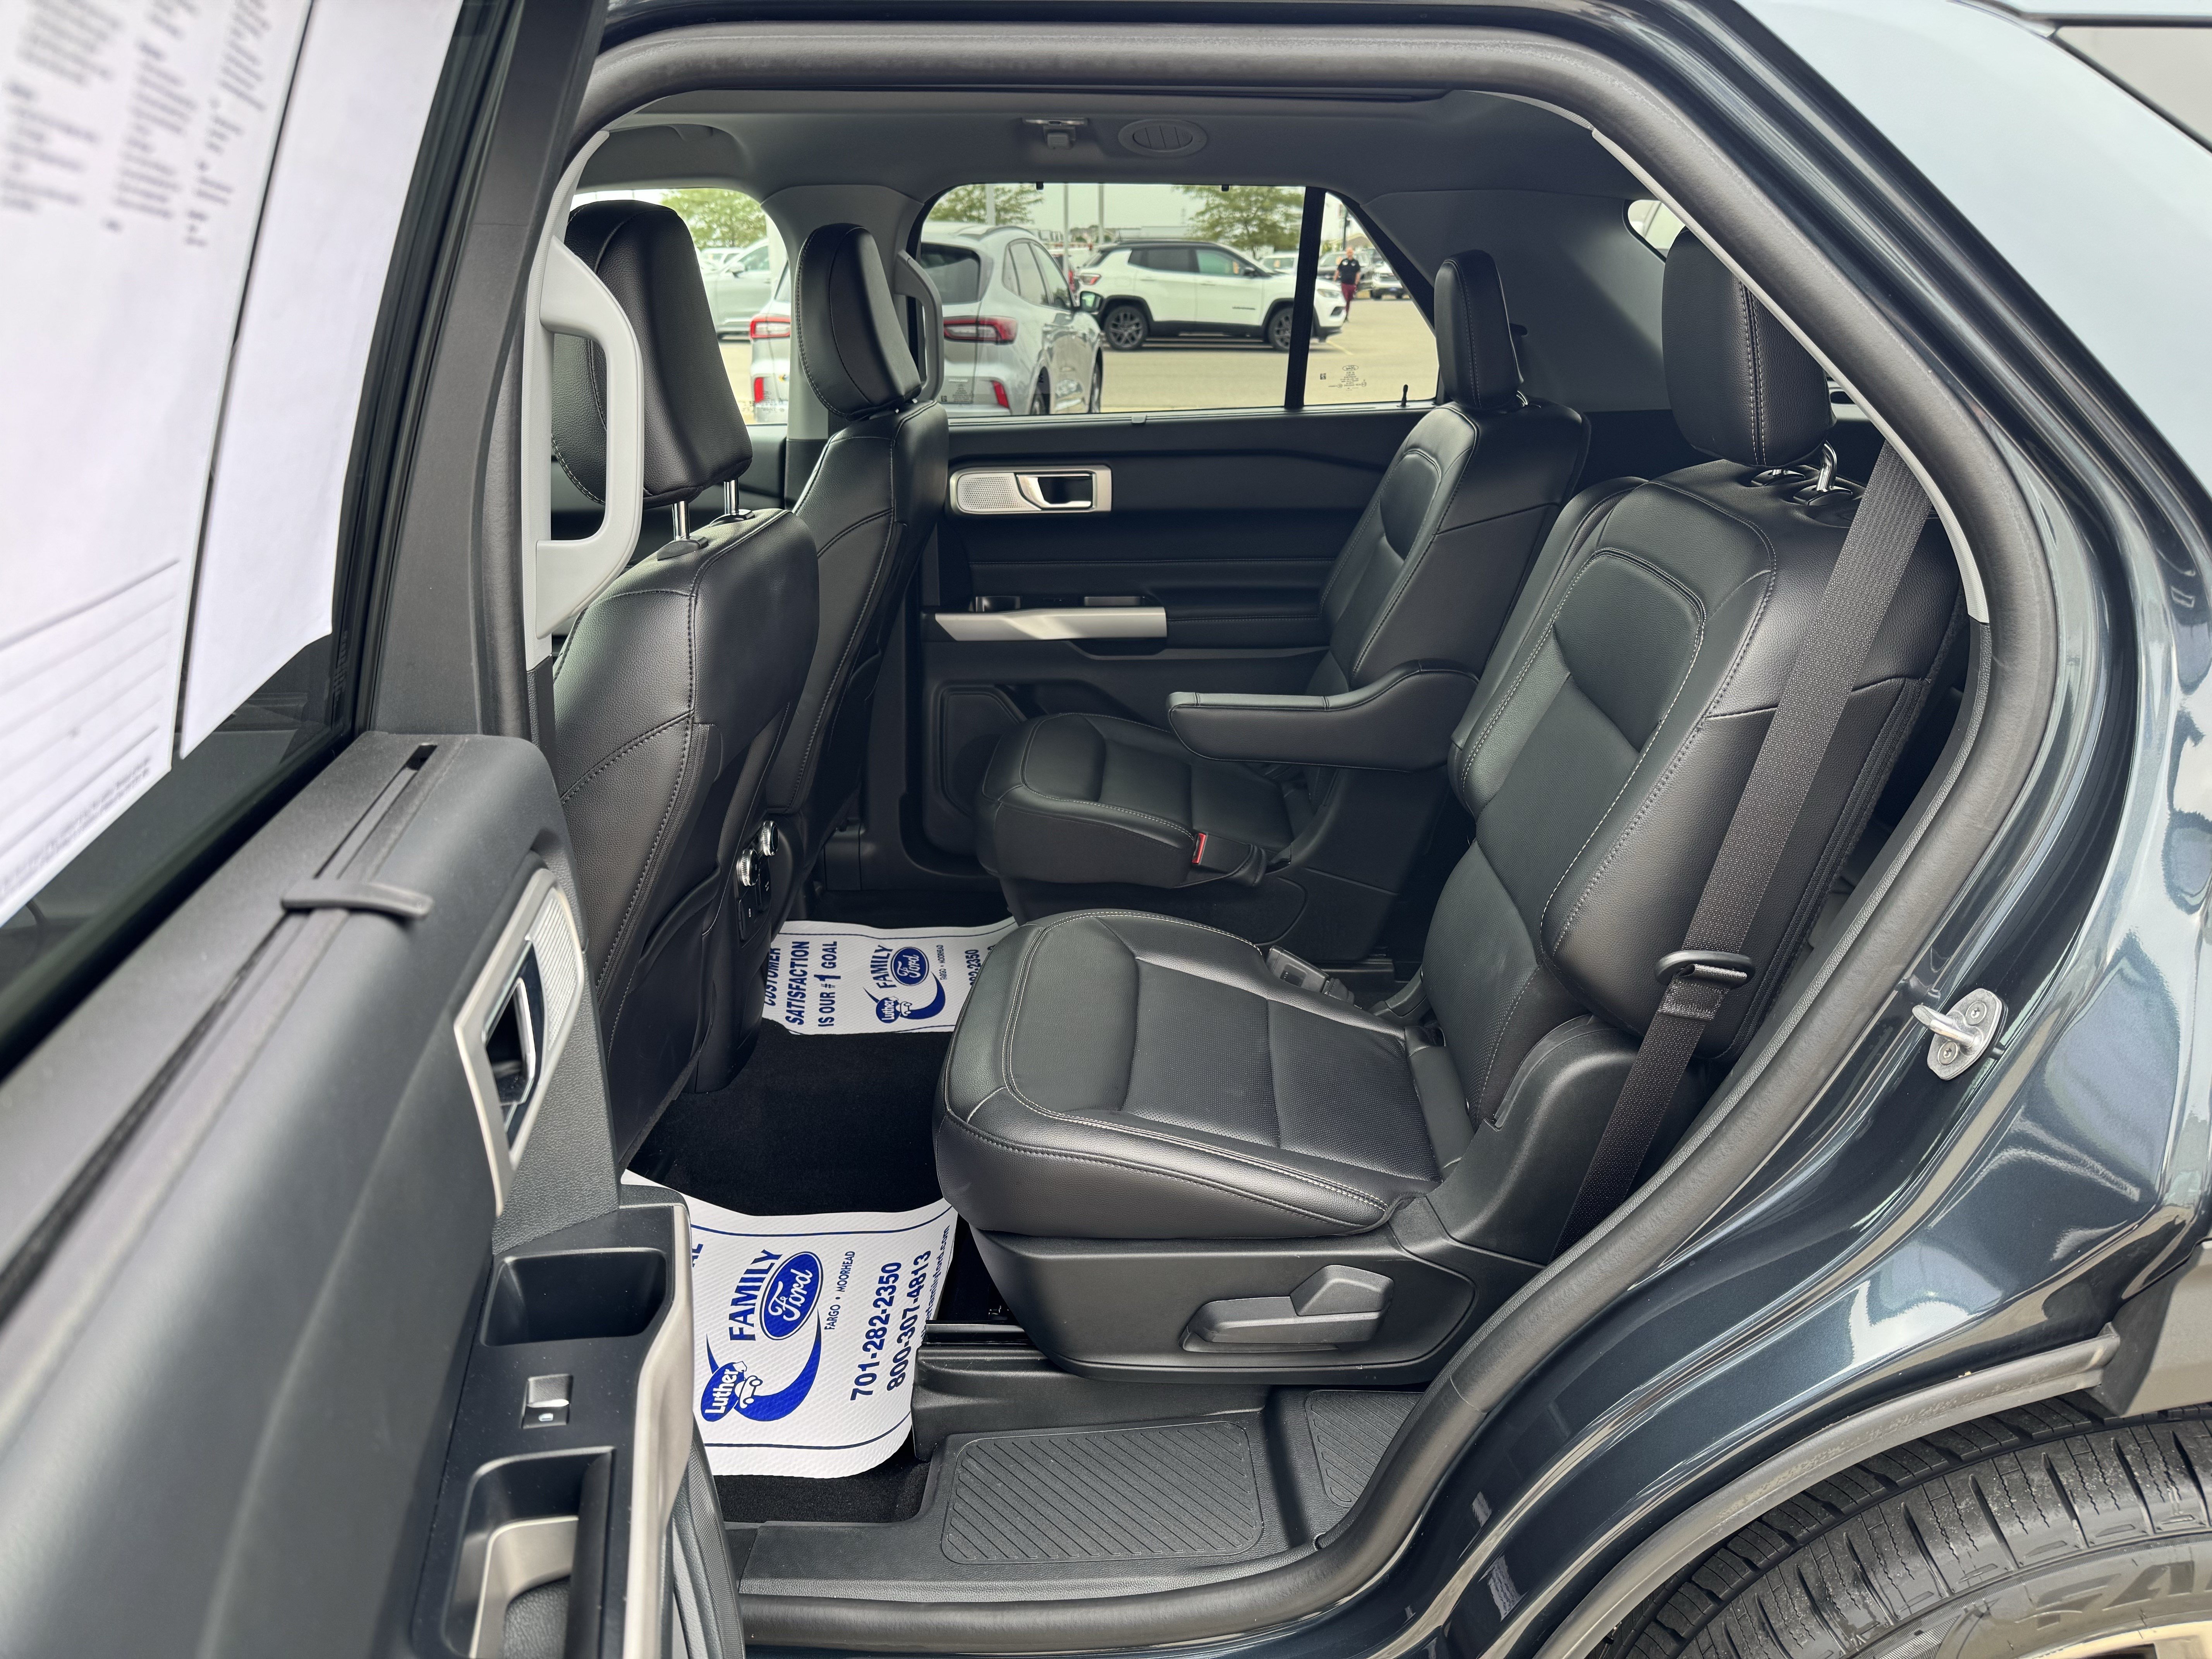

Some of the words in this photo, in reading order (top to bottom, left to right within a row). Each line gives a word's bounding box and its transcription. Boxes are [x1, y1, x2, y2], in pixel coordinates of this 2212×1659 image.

[821, 941, 837, 969] GOAL
[870, 945, 897, 988] FAMILY
[897, 955, 921, 978] Ford
[936, 945, 946, 963] MOORHEAD
[939, 969, 948, 980] FARGO
[785, 941, 810, 1025] SATISFACTION
[819, 992, 836, 1013] OUR
[818, 1017, 835, 1027] IS
[881, 1000, 895, 1020] Luther
[728, 1249, 783, 1341] FAMILY
[768, 1268, 813, 1321] Ford
[824, 1304, 841, 1330] FARGO
[837, 1251, 856, 1292] MOORHEAD
[850, 1262, 902, 1401] 701-282-2350
[886, 1250, 931, 1391] 800-307-4813
[704, 1369, 738, 1414] Luther
